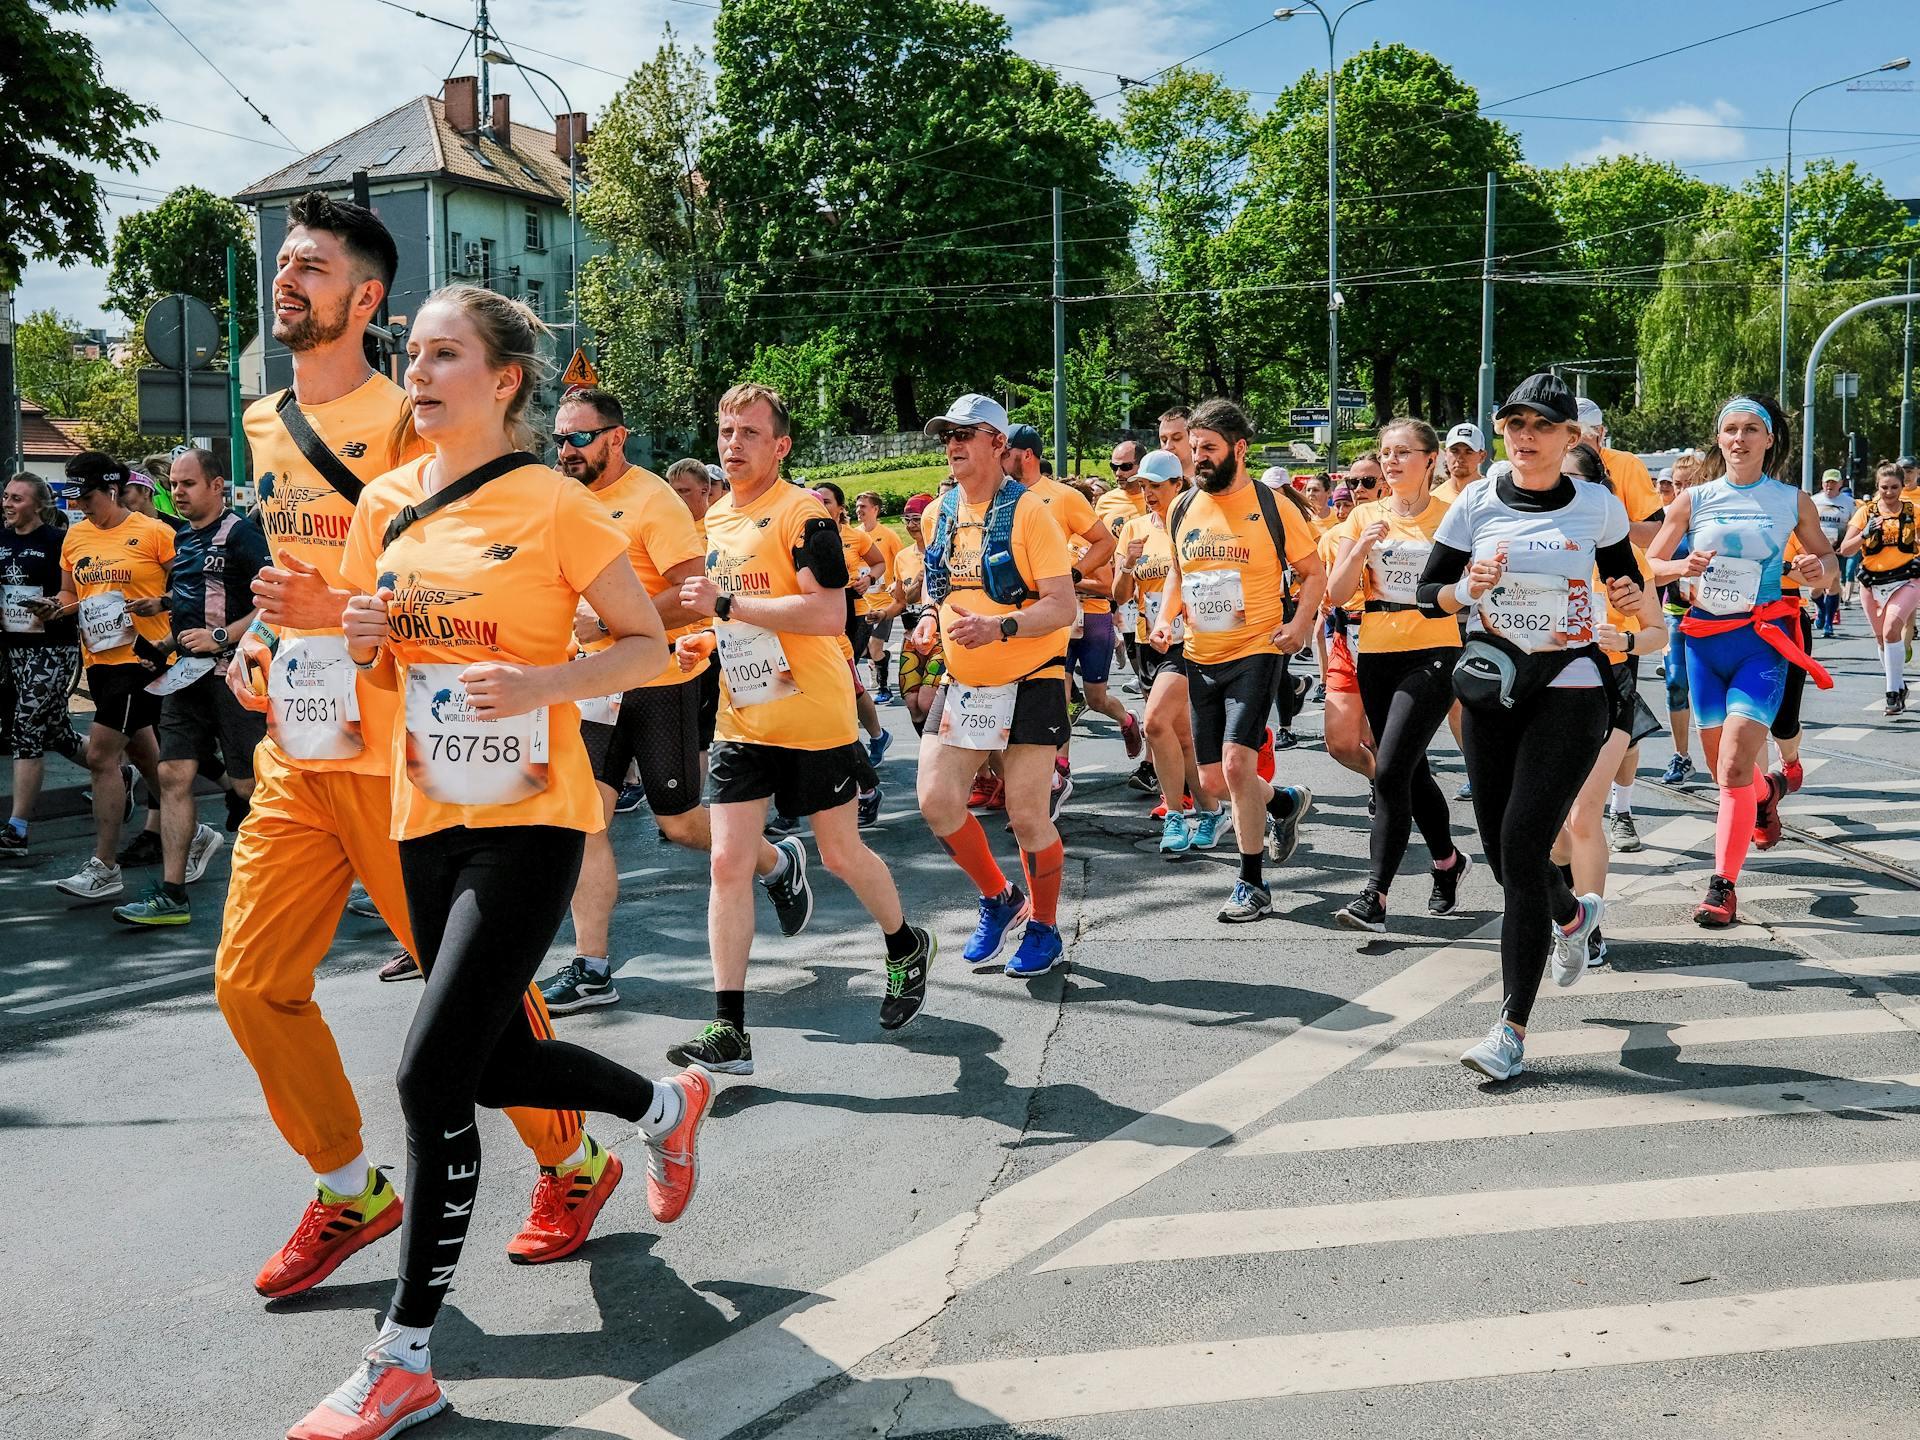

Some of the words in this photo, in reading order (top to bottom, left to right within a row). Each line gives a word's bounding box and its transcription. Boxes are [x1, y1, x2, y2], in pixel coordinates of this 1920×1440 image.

[1529, 541, 1560, 550] ING
[1702, 586, 1740, 602] 9796
[1192, 600, 1232, 614] 19266
[1489, 612, 1551, 632] 23862
[1558, 616, 1566, 628] 4
[778, 656, 786, 667] 4
[726, 659, 773, 684] 11004
[284, 698, 338, 722] 79631
[961, 714, 996, 728] 7596
[428, 734, 521, 763] 76758
[428, 1160, 478, 1288] NIKE
